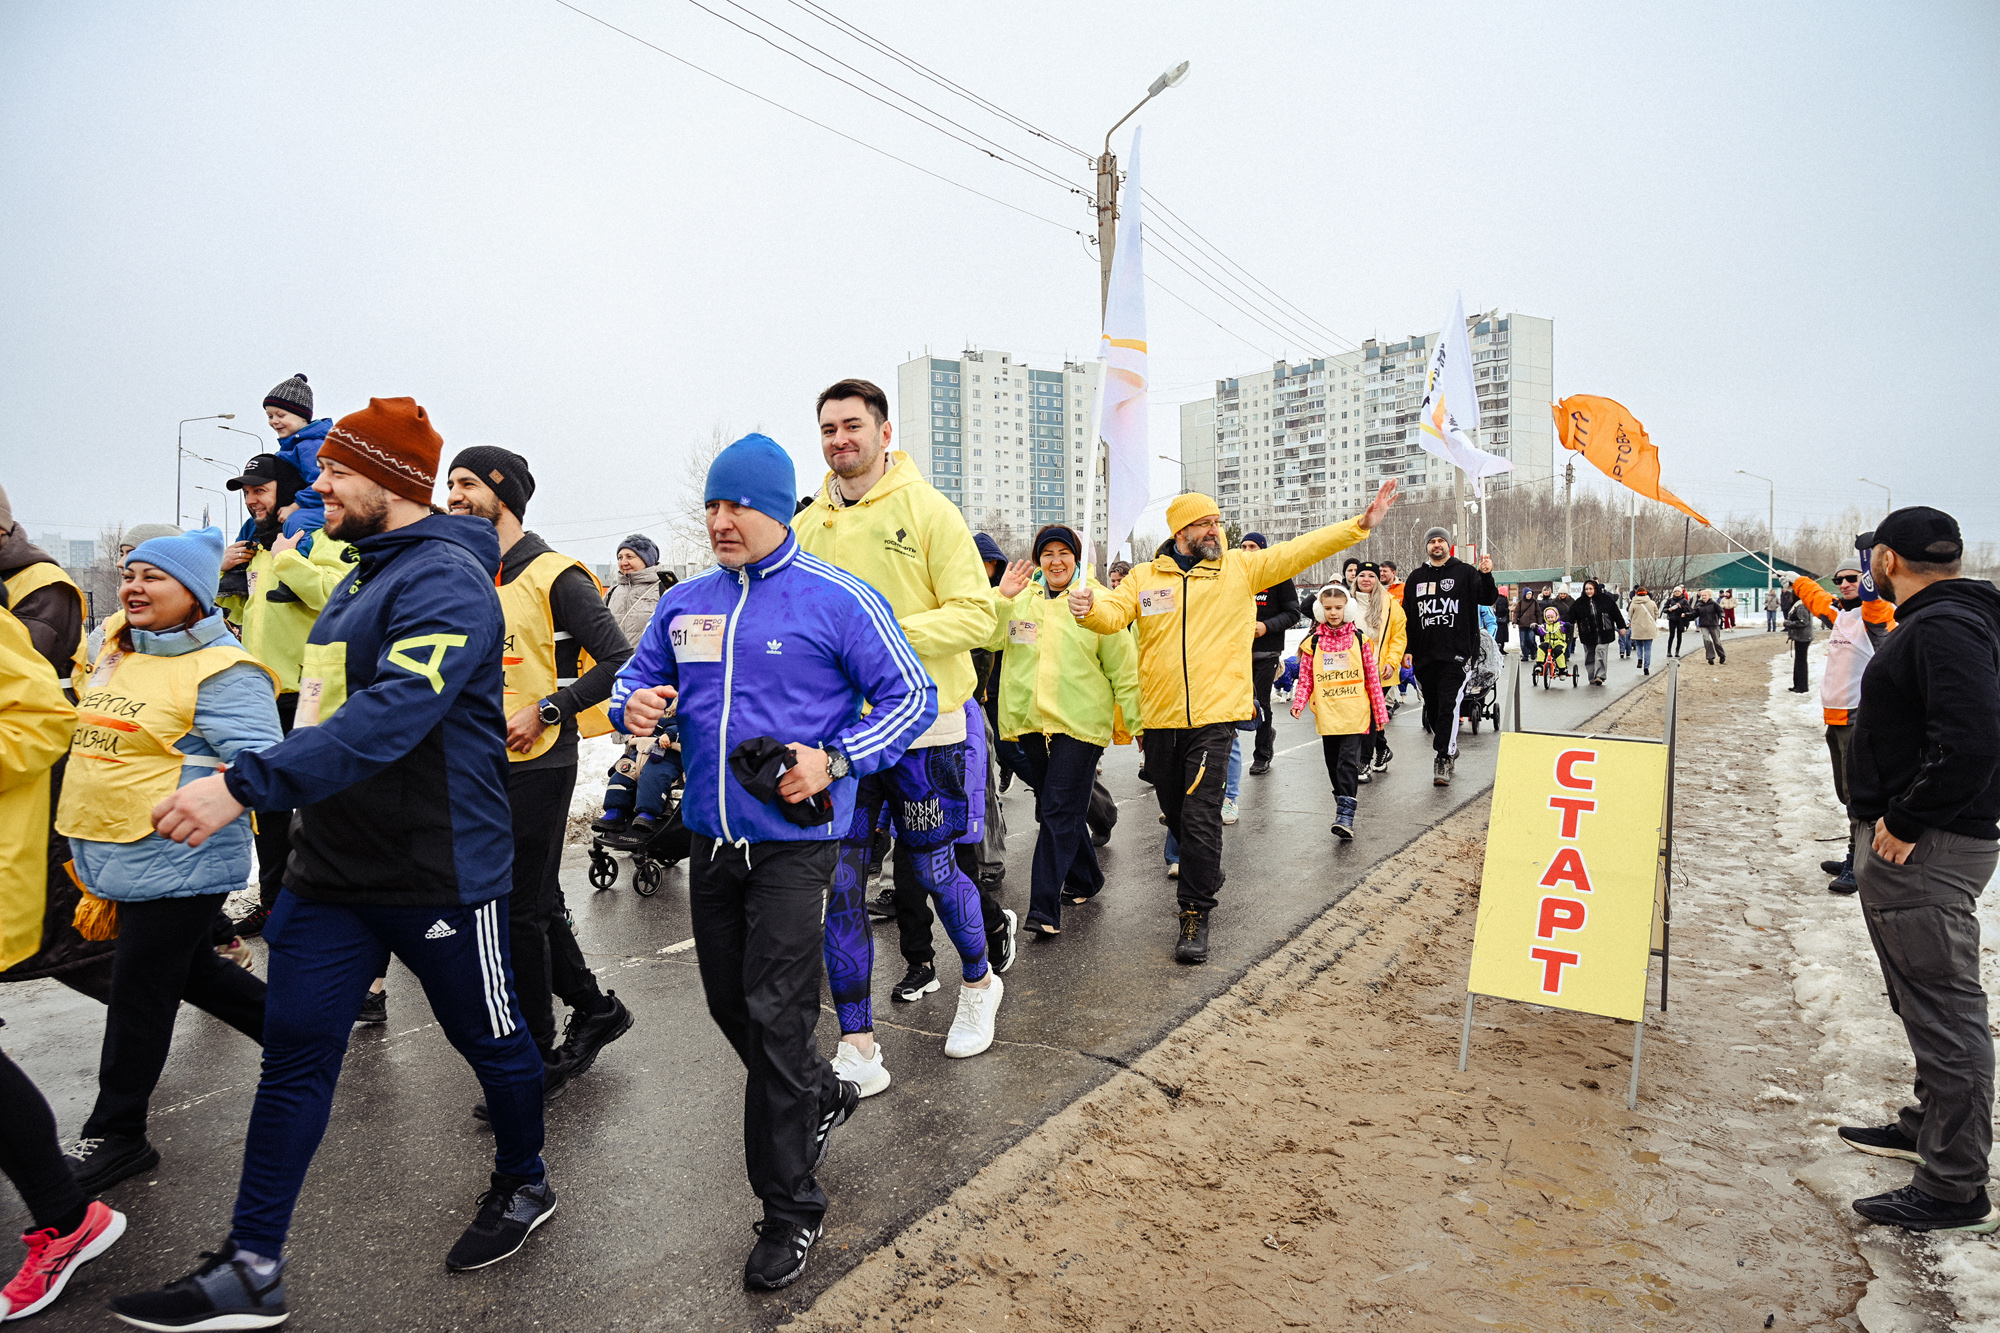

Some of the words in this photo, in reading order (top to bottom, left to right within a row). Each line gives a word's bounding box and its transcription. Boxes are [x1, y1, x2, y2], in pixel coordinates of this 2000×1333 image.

[1142, 597, 1152, 608] 66
[1417, 598, 1459, 617] BKLYN
[672, 629, 688, 646] 251
[1316, 669, 1359, 682] ЭНЕРГИЯ
[1322, 687, 1358, 698] ЖИЗНИ
[1530, 749, 1598, 994] СТАРТ
[425, 929, 457, 939] adidas
